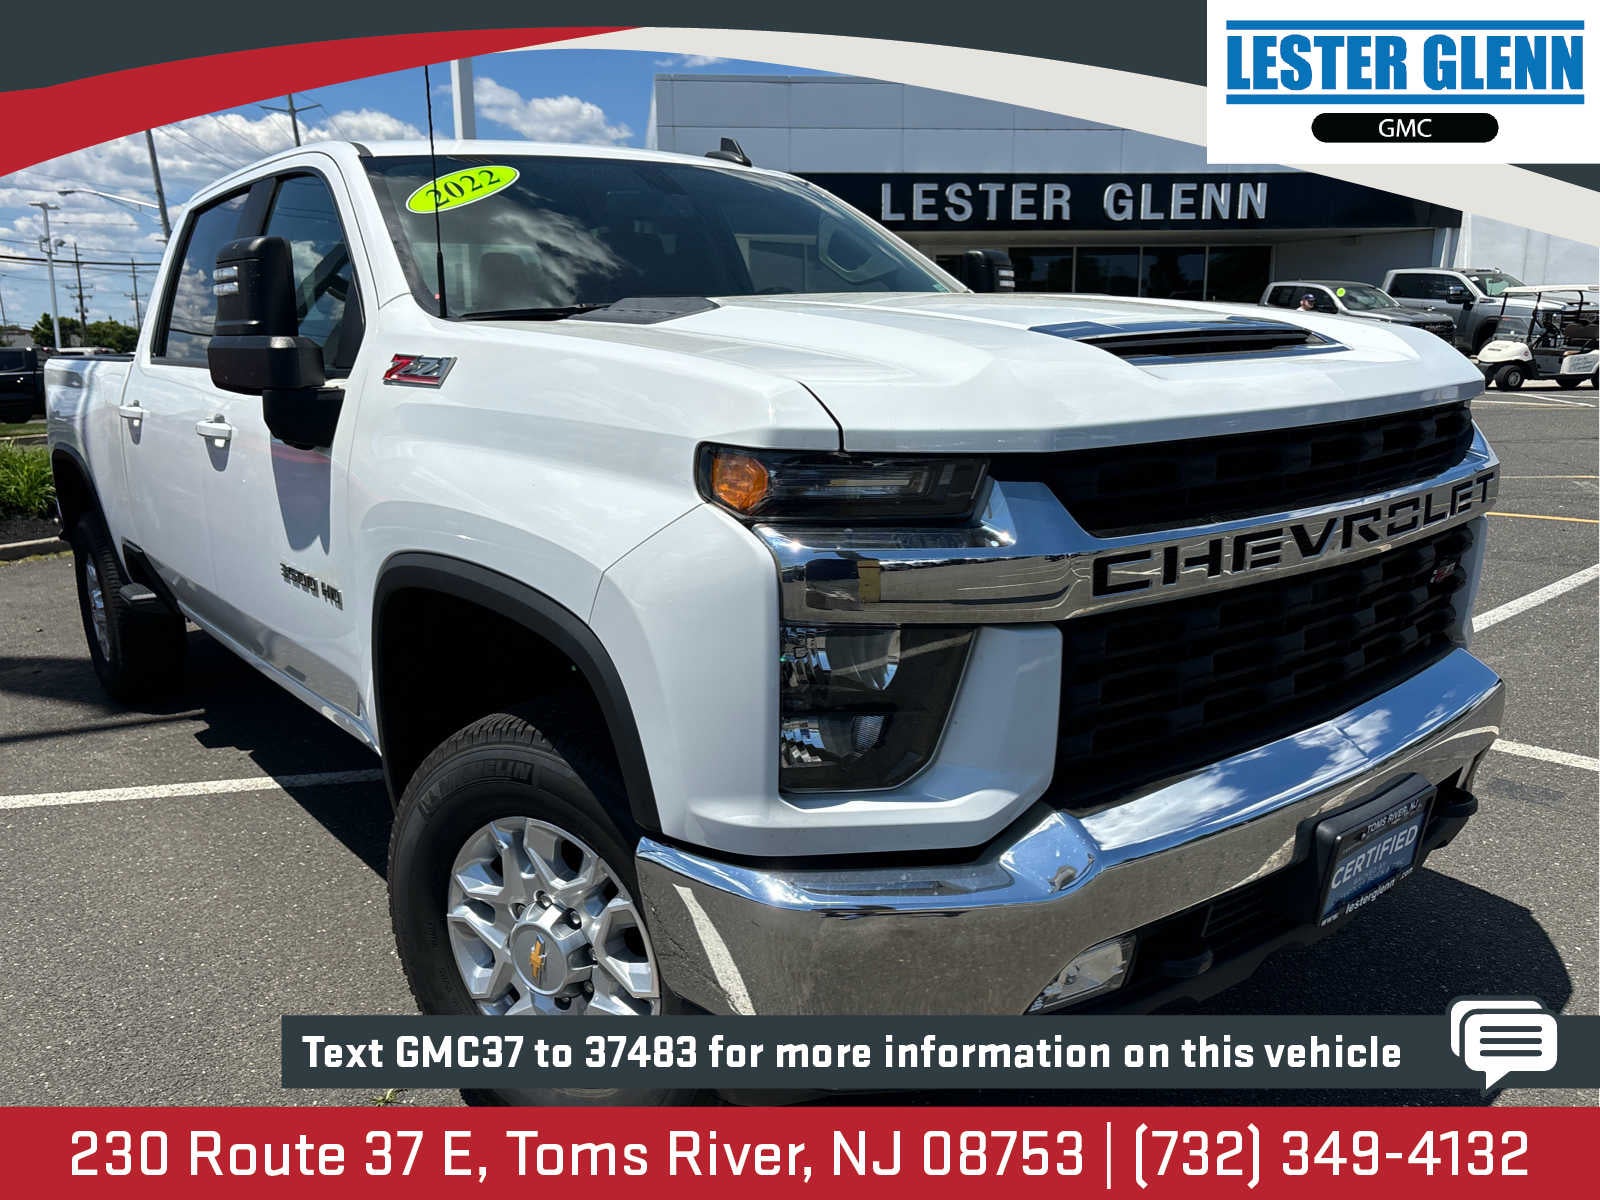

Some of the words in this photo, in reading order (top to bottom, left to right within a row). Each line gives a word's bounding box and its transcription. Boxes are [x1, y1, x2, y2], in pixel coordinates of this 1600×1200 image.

[425, 169, 501, 208] 2022
[881, 183, 1072, 222] LESTER
[1103, 182, 1268, 221] GLENN
[382, 353, 457, 389] Z71
[1092, 471, 1496, 598] CHEVROLET
[1331, 824, 1419, 890] CERTIFIED
